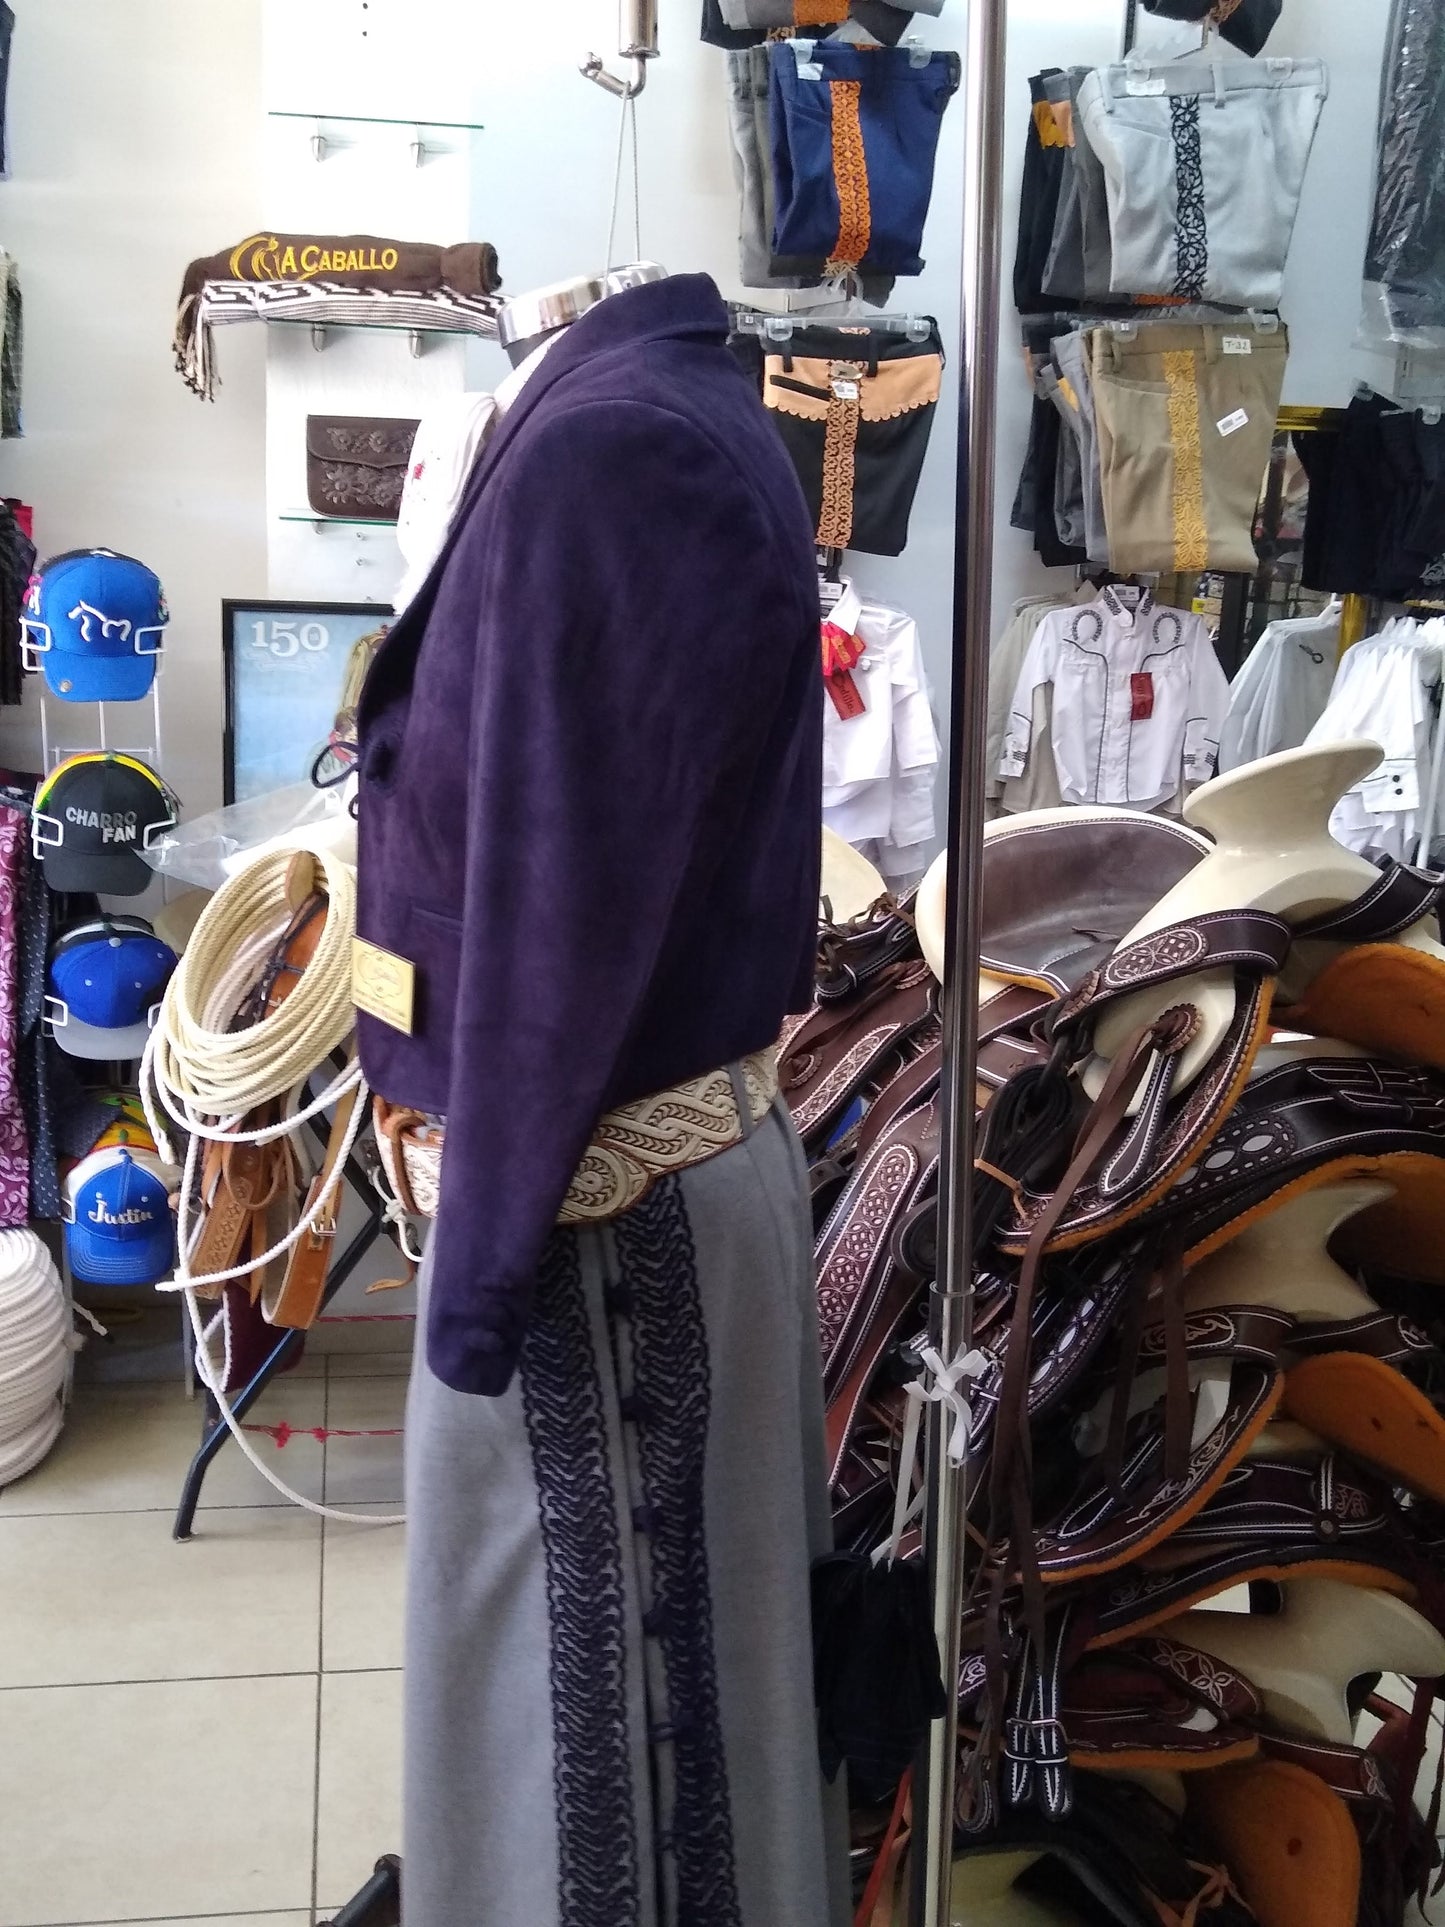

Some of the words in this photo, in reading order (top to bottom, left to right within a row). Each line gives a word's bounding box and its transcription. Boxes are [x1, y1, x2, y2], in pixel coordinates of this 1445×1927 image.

[281, 246, 298, 273] A
[300, 245, 398, 271] CABALLO
[251, 621, 330, 657] 150
[65, 806, 138, 829] CHARRO
[102, 825, 136, 843] FAN
